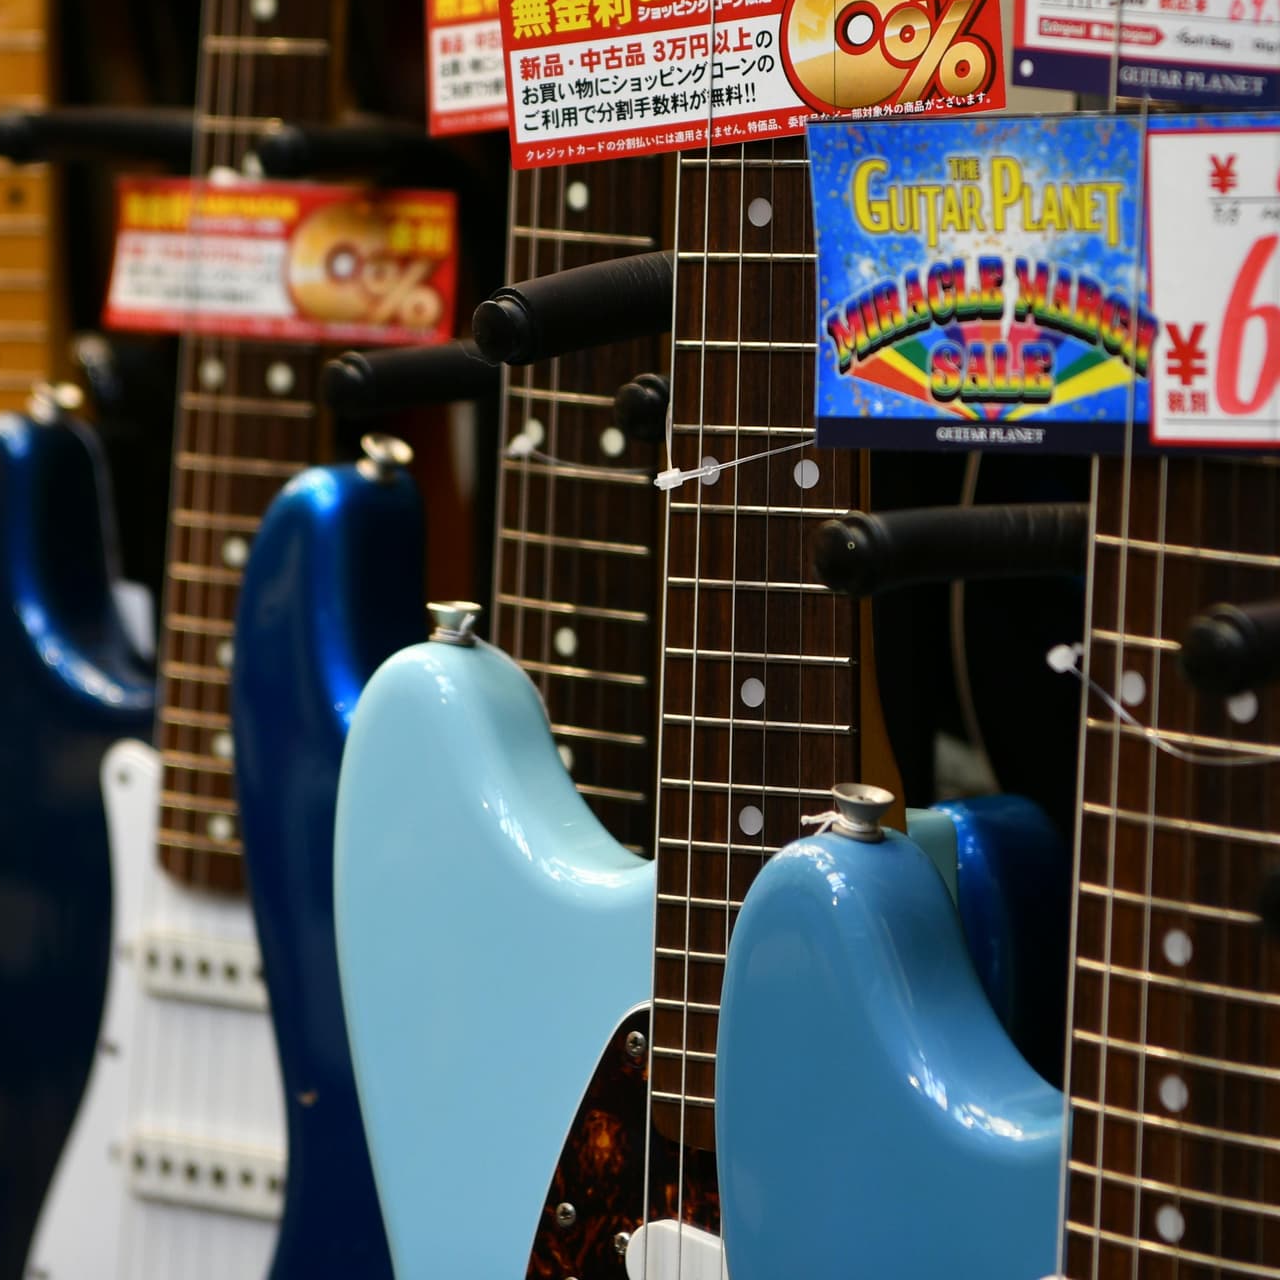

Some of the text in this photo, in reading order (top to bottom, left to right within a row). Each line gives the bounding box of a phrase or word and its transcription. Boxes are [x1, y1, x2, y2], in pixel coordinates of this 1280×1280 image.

[520, 43, 646, 81] 新品・中古品
[1120, 65, 1267, 96] GUITAR PLANET
[947, 157, 981, 181] THE
[852, 156, 1124, 248] GUITAR PLANET
[930, 341, 1053, 404] SALE
[1165, 322, 1207, 386] ¥
